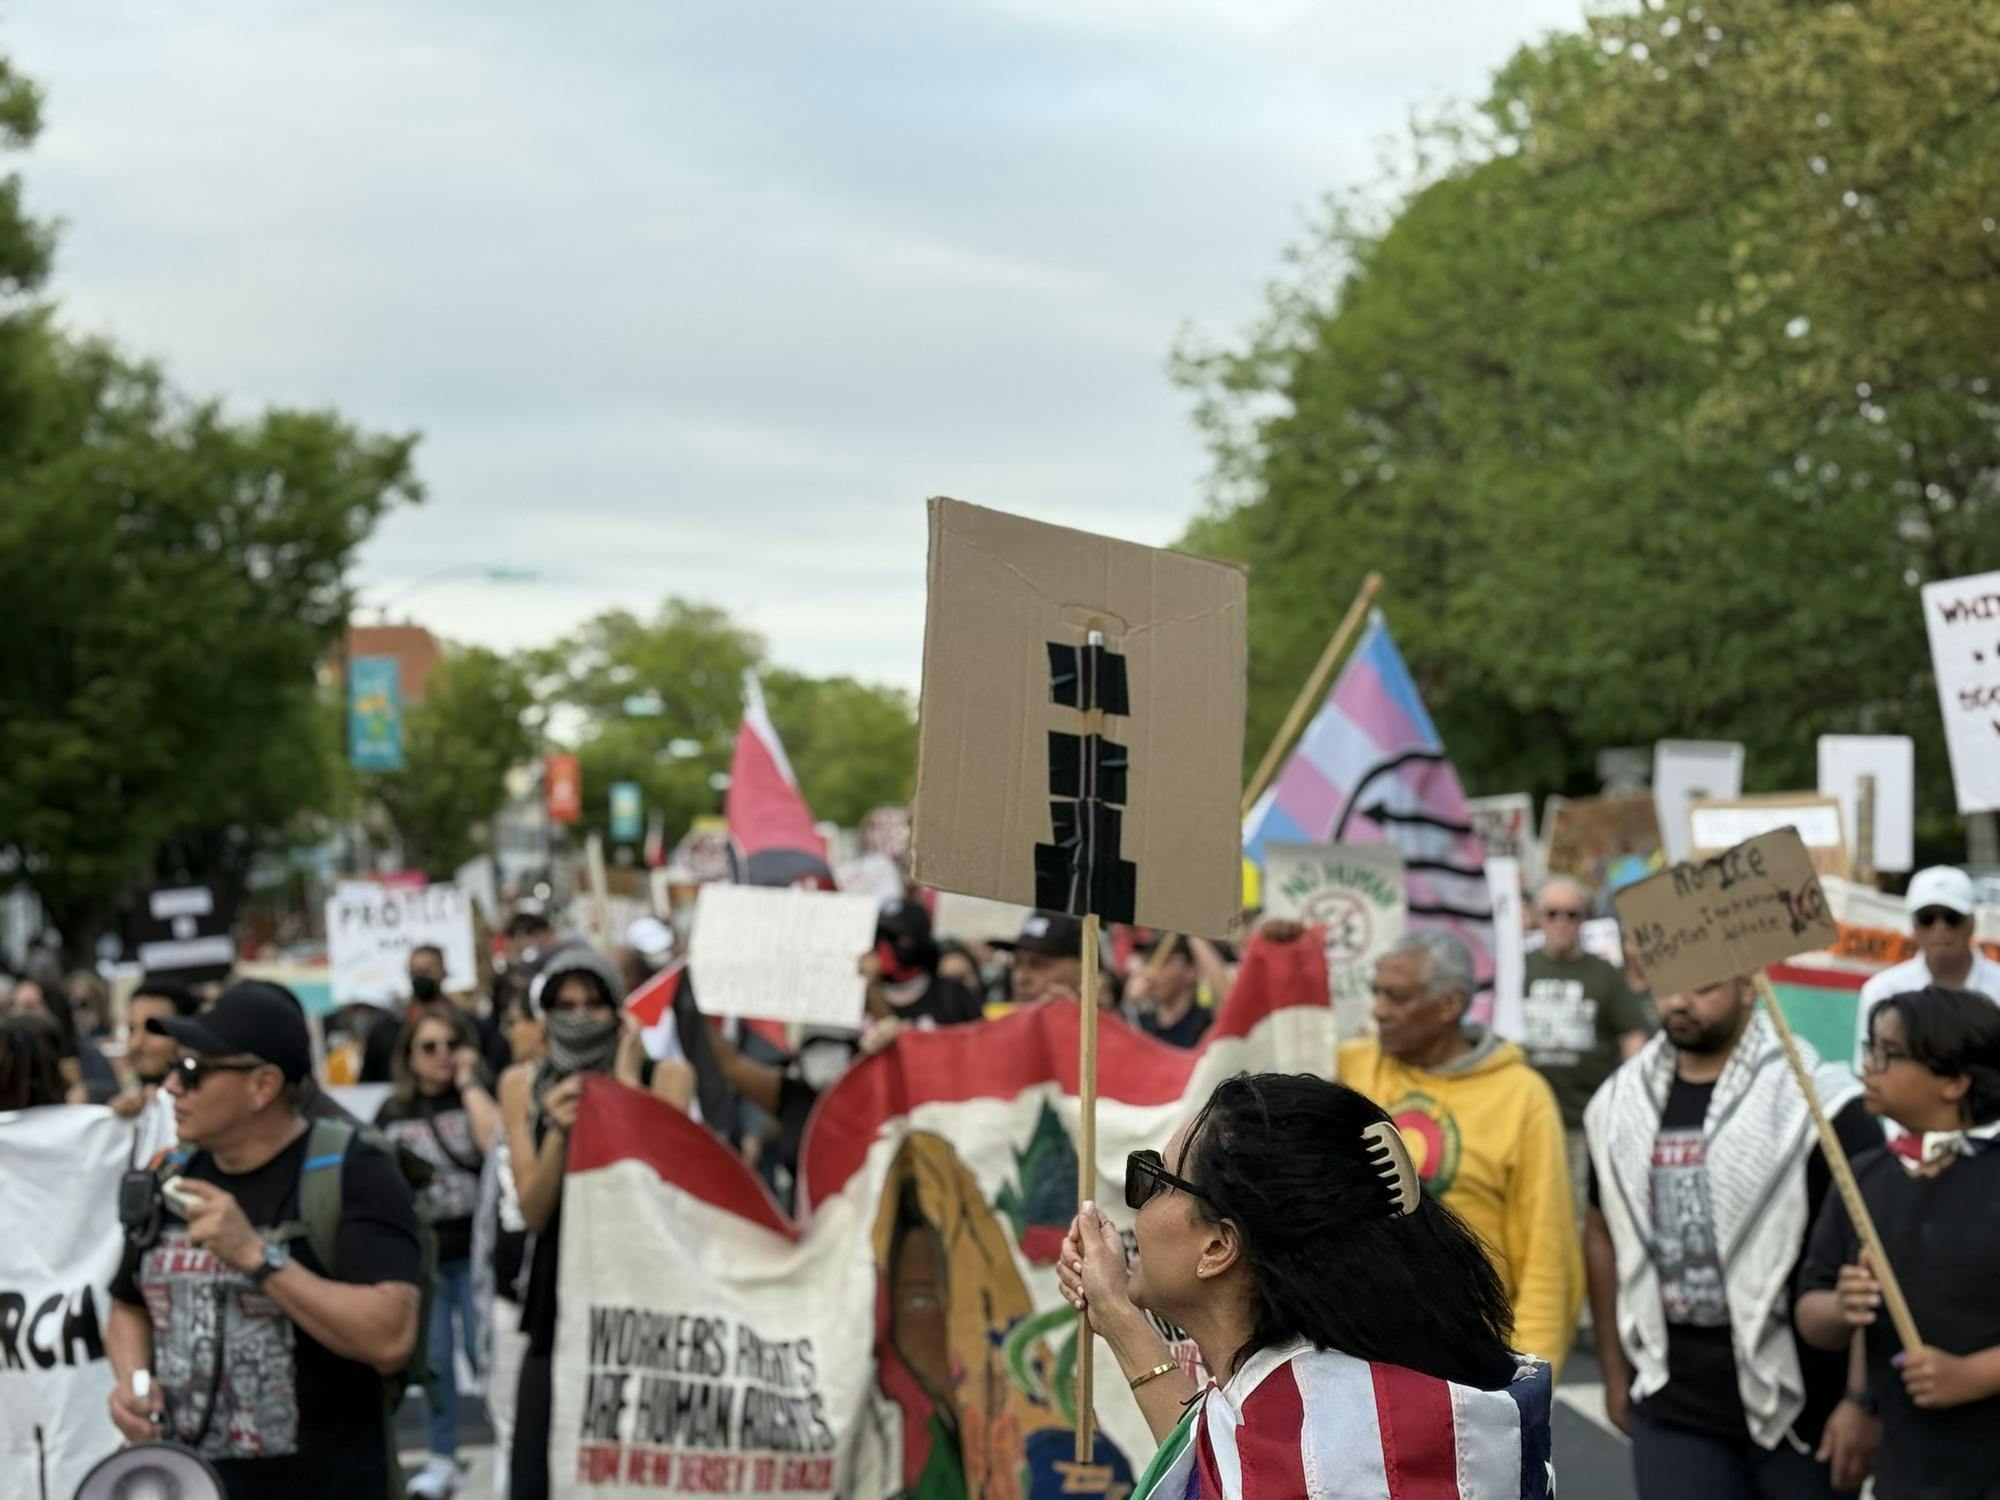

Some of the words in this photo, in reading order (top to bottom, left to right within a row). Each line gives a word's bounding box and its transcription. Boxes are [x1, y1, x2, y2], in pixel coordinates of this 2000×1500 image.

[0, 1284, 106, 1370] RCH
[590, 1307, 727, 1377] WORKERS
[737, 1323, 817, 1389] RIGHTS
[581, 1373, 630, 1440] ARE
[633, 1375, 735, 1447] HUMAN
[740, 1386, 835, 1452] RIGHTS
[577, 1444, 621, 1486] FROM
[628, 1446, 671, 1487] NEW
[675, 1452, 746, 1494] JERSEY
[752, 1456, 777, 1493] TO
[781, 1456, 836, 1493] GAZA
